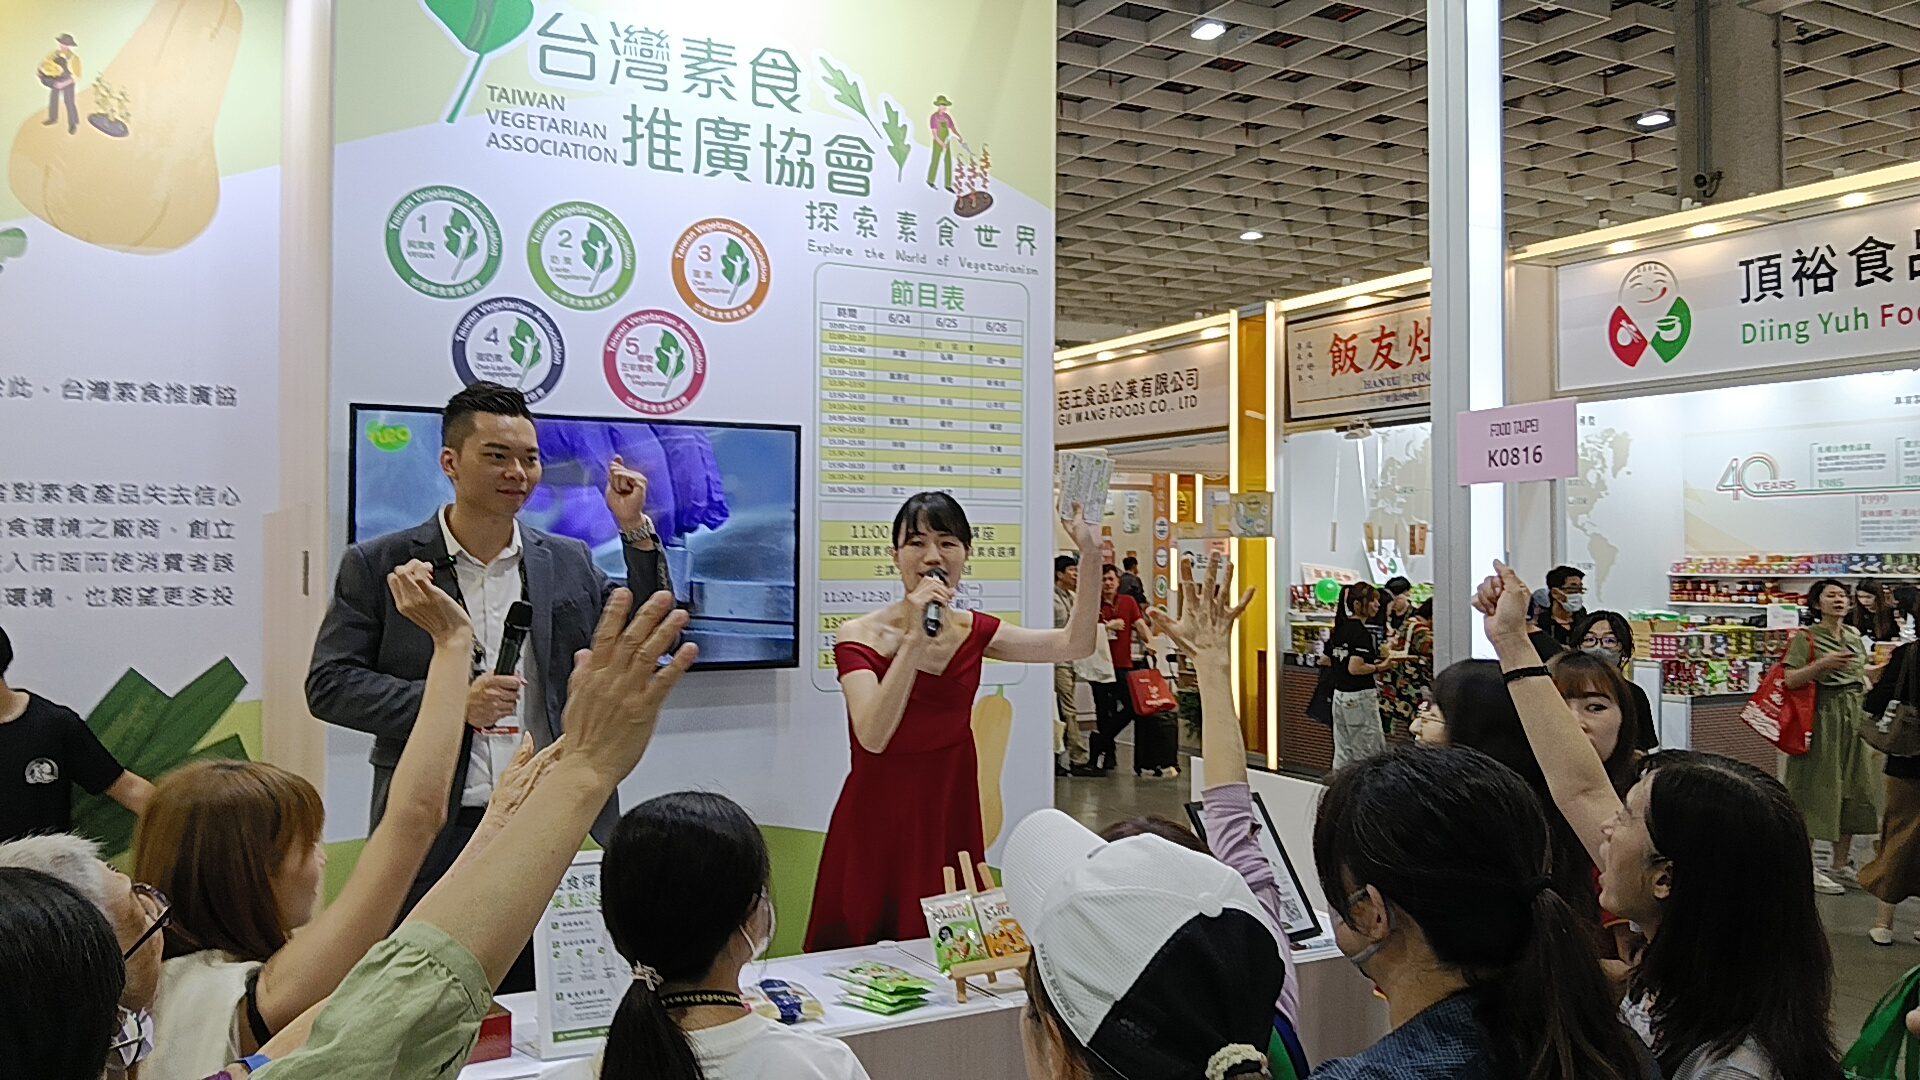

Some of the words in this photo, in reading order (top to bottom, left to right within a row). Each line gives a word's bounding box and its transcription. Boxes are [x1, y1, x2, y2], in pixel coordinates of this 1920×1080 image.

[537, 12, 803, 113] 台灣素食
[486, 85, 565, 111] TAIWAN
[486, 108, 607, 140] VEGETARIAN
[486, 132, 617, 164] ASSOCIATION
[622, 103, 876, 198] 推廣協會
[417, 215, 426, 233] 1
[805, 201, 1038, 256] 探索素食世界
[558, 230, 573, 248] 2
[698, 244, 711, 262] 3
[807, 239, 854, 258] Explore
[864, 248, 885, 260] the
[896, 250, 928, 265] World
[937, 255, 950, 267] of
[958, 256, 1039, 276] Vegetarianism
[1739, 229, 1920, 304] 頂裕食
[890, 279, 965, 311] 節目表
[888, 312, 911, 325] 6/24
[936, 317, 958, 329] 6/25
[986, 321, 1008, 333] 6/26
[1742, 318, 1810, 345] Diing
[1817, 306, 1869, 335] Yuh
[1880, 303, 1920, 328] Fo
[483, 326, 499, 346] 4
[625, 337, 640, 355] 5
[1058, 413, 1071, 426] GU
[1075, 407, 1106, 423] WANG
[1109, 402, 1146, 419] FOODS
[1489, 422, 1511, 438] FOOD
[1488, 444, 1543, 468] K0816
[1753, 479, 1797, 491] YEARS
